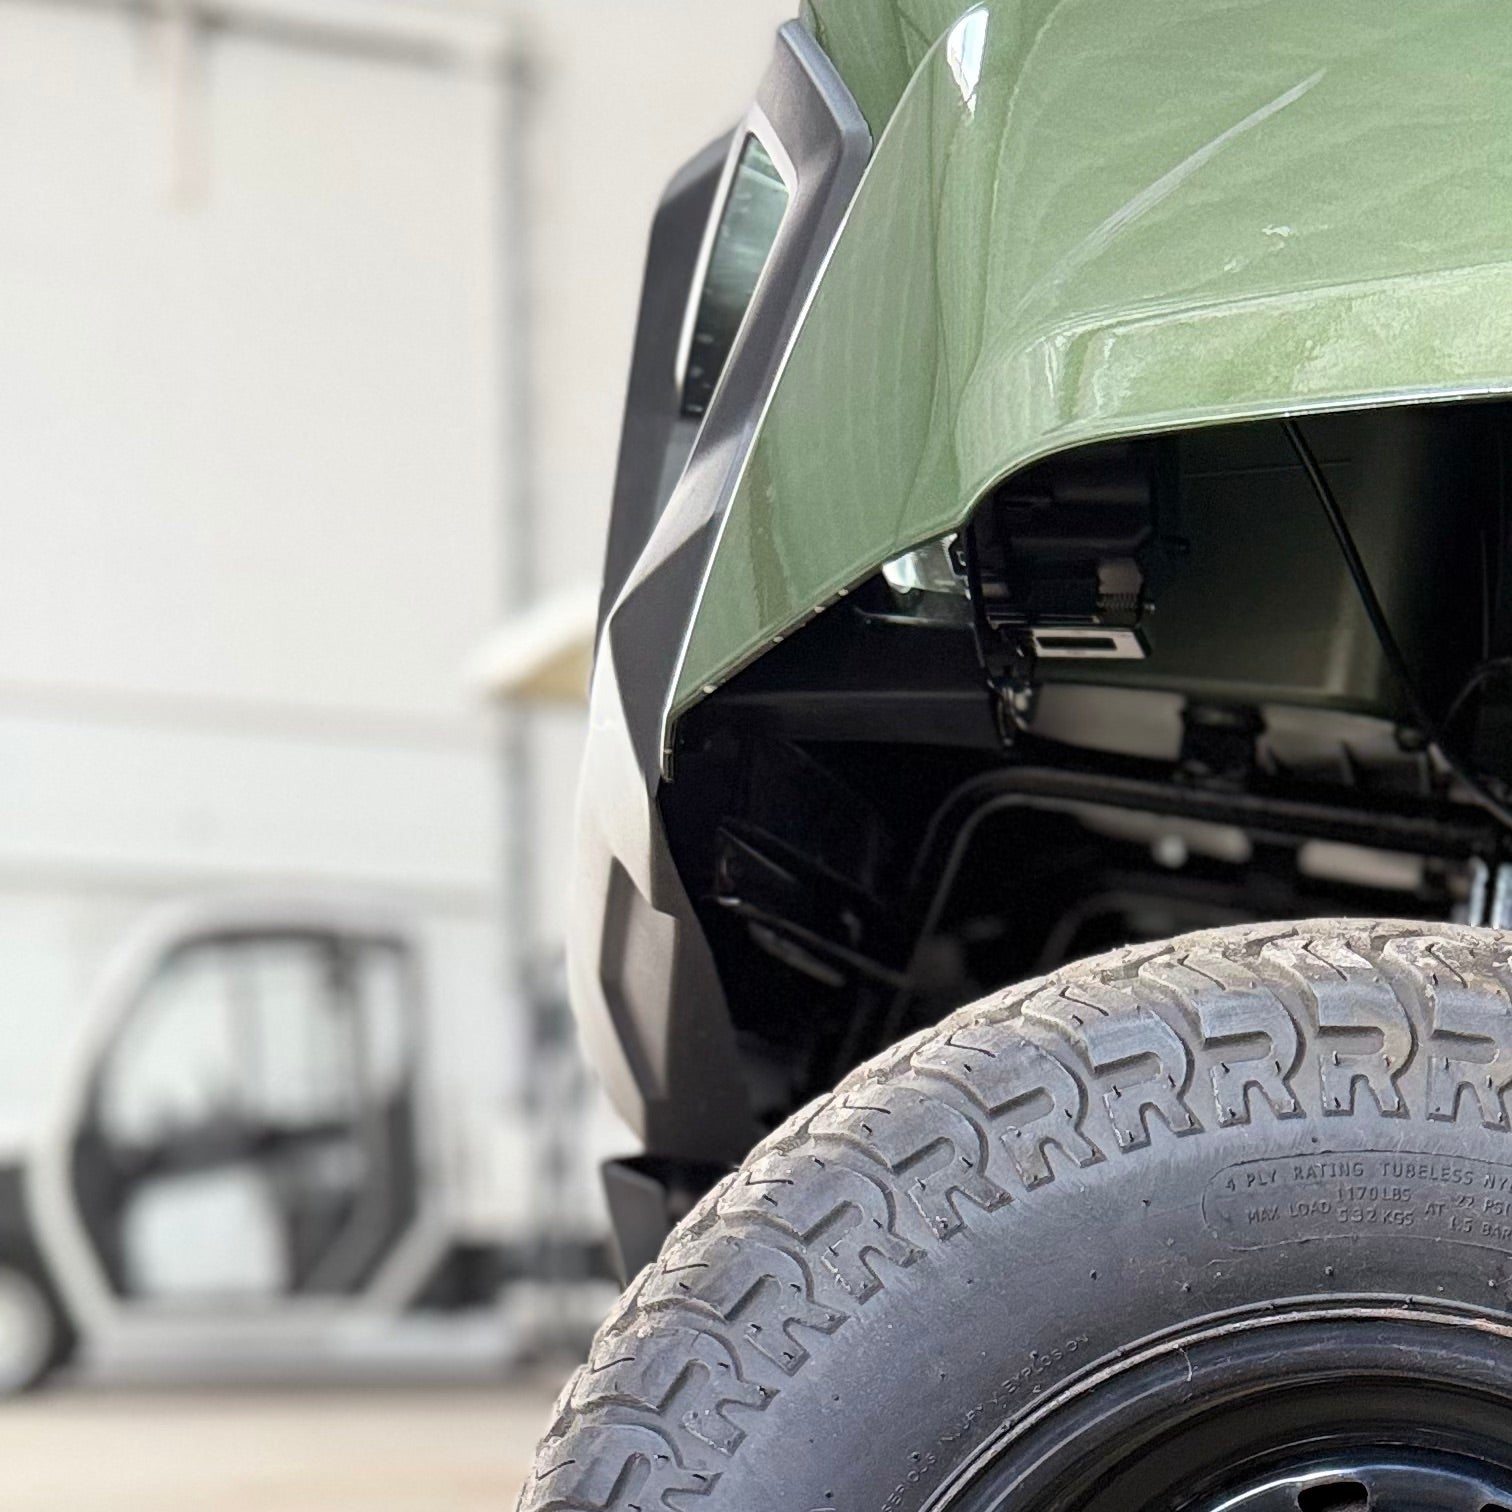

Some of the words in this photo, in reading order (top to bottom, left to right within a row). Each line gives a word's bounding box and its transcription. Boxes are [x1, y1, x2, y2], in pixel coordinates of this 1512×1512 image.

[1246, 1169, 1278, 1188] PLY
[1293, 1162, 1365, 1181] RATING
[1379, 1161, 1474, 1186] TUBELESS
[1247, 1205, 1281, 1225] MAX
[1287, 1200, 1333, 1219] LOAD
[1424, 1202, 1447, 1218] AT
[1482, 1198, 1512, 1217] PSI
[998, 1327, 1090, 1395] EXPLOSON
